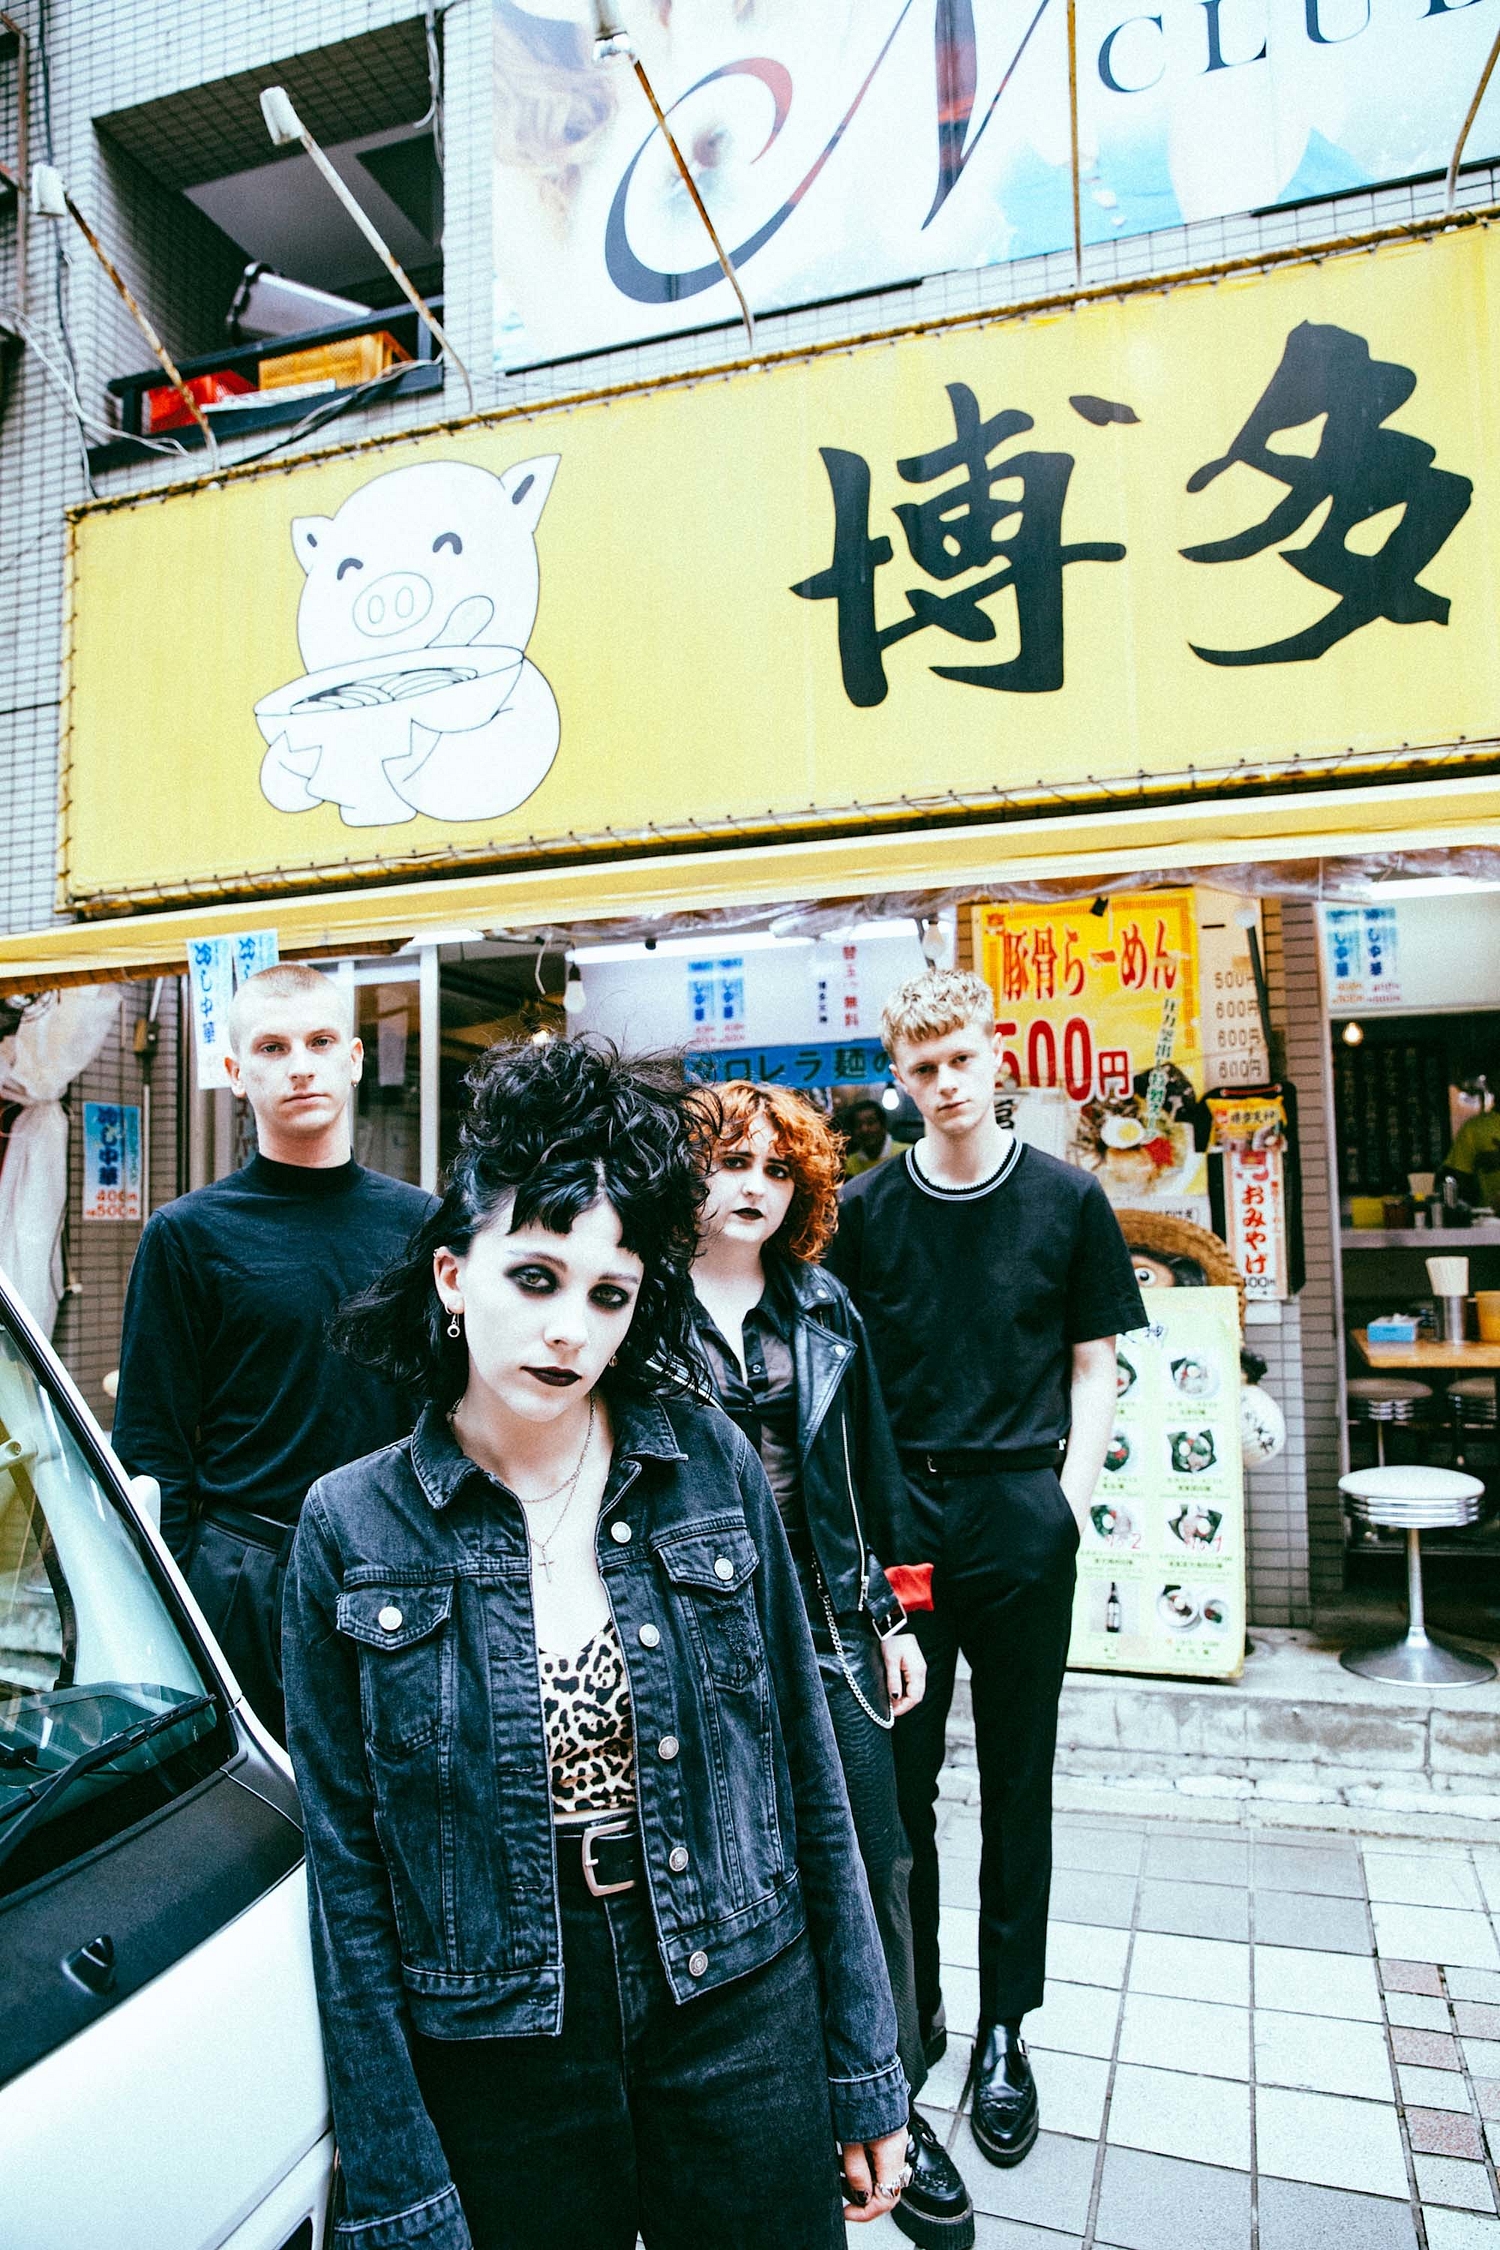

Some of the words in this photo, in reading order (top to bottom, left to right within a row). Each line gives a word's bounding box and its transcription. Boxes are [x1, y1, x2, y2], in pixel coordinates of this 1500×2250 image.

[1098, 0, 1482, 93] CLU
[788, 319, 1474, 708] 博多
[1002, 919, 1178, 1002] 豚骨らーめん
[1243, 1184, 1267, 1275] おみやげ
